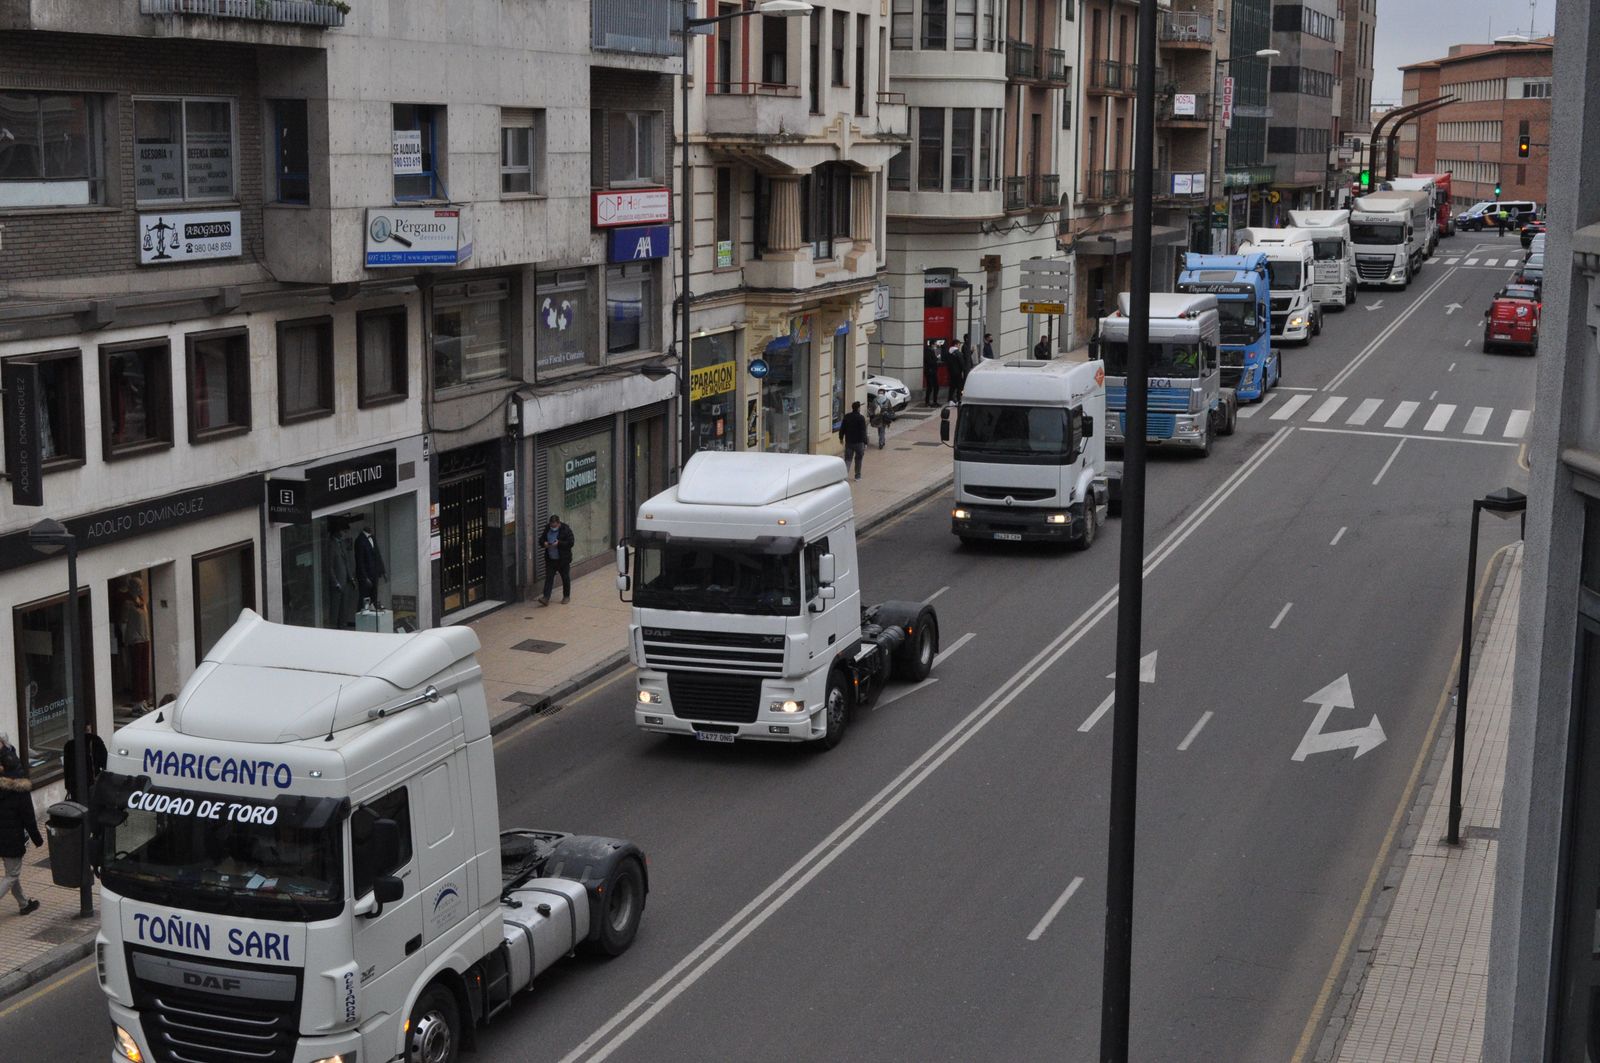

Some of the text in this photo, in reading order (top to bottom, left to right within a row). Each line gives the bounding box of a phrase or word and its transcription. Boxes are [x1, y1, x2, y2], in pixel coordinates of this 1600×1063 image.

[1176, 95, 1194, 105] HOSTAL
[1221, 78, 1233, 129] HOSTAL
[393, 143, 420, 155] SE ALQUILA
[186, 223, 231, 237] ABOGADOS
[395, 218, 446, 237] Pérgamo
[194, 241, 232, 253] 980 048 859
[633, 236, 652, 259] AXA
[691, 364, 733, 391] EPARACIÓN
[702, 386, 709, 396] DE
[17, 377, 29, 493] ADOLFO DOMINGUEZ
[575, 455, 596, 468] home
[328, 465, 382, 492] FLORENTINO
[566, 469, 597, 491] DISPONIBLE
[88, 497, 204, 539] ADOLFO DOMINGUEZ
[643, 629, 672, 638] DAF
[760, 635, 784, 644] XF
[143, 748, 292, 789] MARICANTO
[127, 790, 278, 825] CIUDAD DE TORO
[134, 913, 290, 961] TOÑIN SARI
[183, 971, 241, 991] DAF
